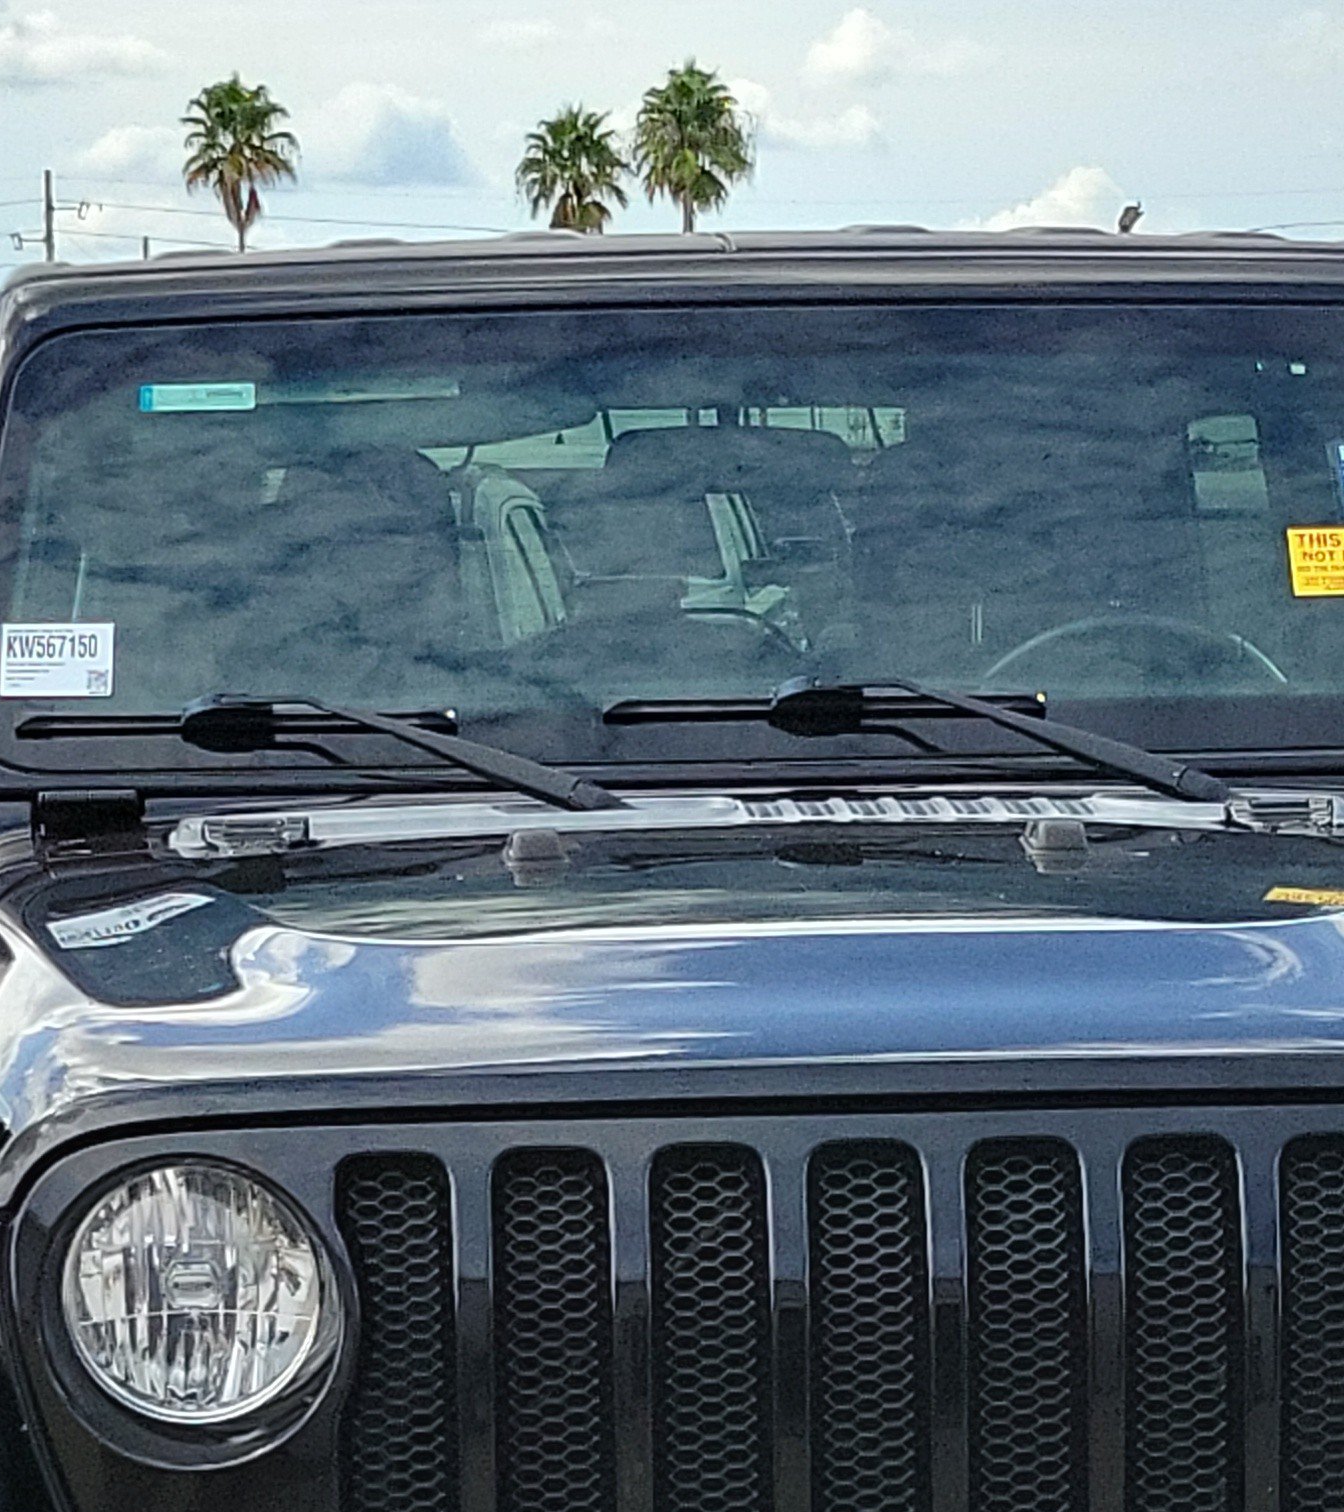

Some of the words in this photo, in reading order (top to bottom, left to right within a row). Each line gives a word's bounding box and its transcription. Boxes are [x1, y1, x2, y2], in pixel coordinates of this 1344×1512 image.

[1297, 533, 1342, 548] THIS
[1302, 550, 1336, 563] NOT
[6, 634, 98, 659] KW567150
